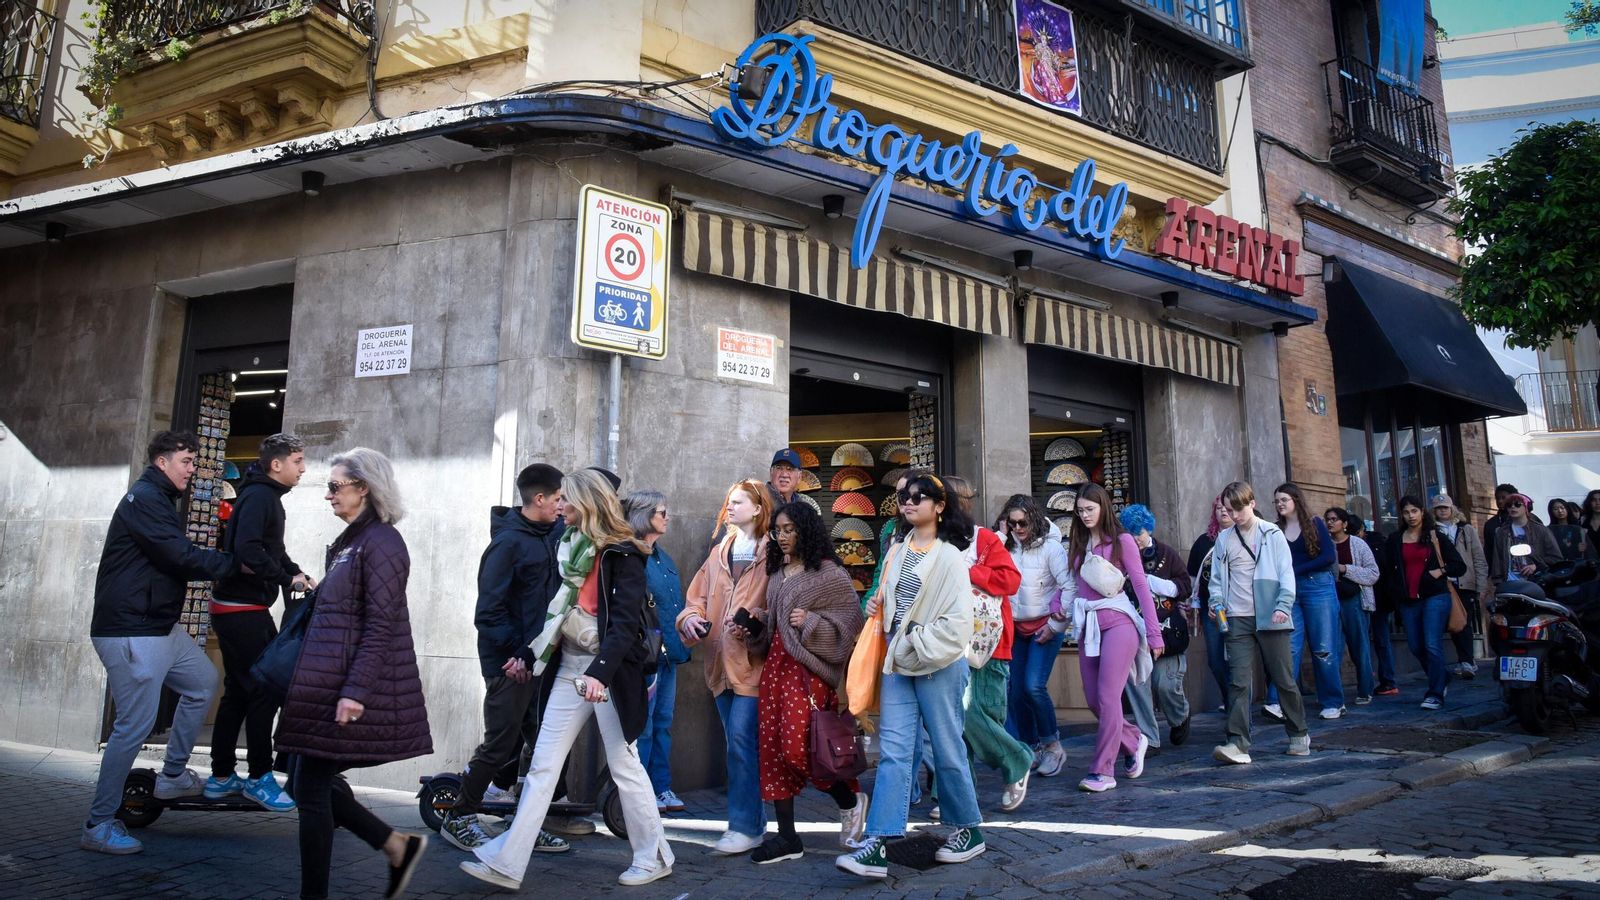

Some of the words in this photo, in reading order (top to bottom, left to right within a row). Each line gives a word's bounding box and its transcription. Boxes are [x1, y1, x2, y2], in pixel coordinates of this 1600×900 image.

[711, 33, 1046, 270] Droguería
[1048, 159, 1128, 259] del
[1155, 197, 1305, 297] ARENAL
[596, 199, 661, 225] ATENCIÓN
[610, 219, 643, 236] ZONA
[614, 247, 637, 266] 20
[598, 285, 648, 303] PRIORIDAD
[361, 342, 375, 350] DEL
[379, 339, 408, 348] ARENAL
[722, 342, 737, 351] DEL
[360, 361, 373, 372] 954
[375, 360, 384, 371] 22
[386, 359, 395, 370] 37
[397, 358, 407, 369] 29
[722, 361, 736, 372] 954
[738, 363, 748, 375] 22
[750, 365, 759, 376] 37
[760, 367, 770, 378] 29
[1509, 658, 1535, 669] 1460
[1508, 668, 1528, 678] HFC
